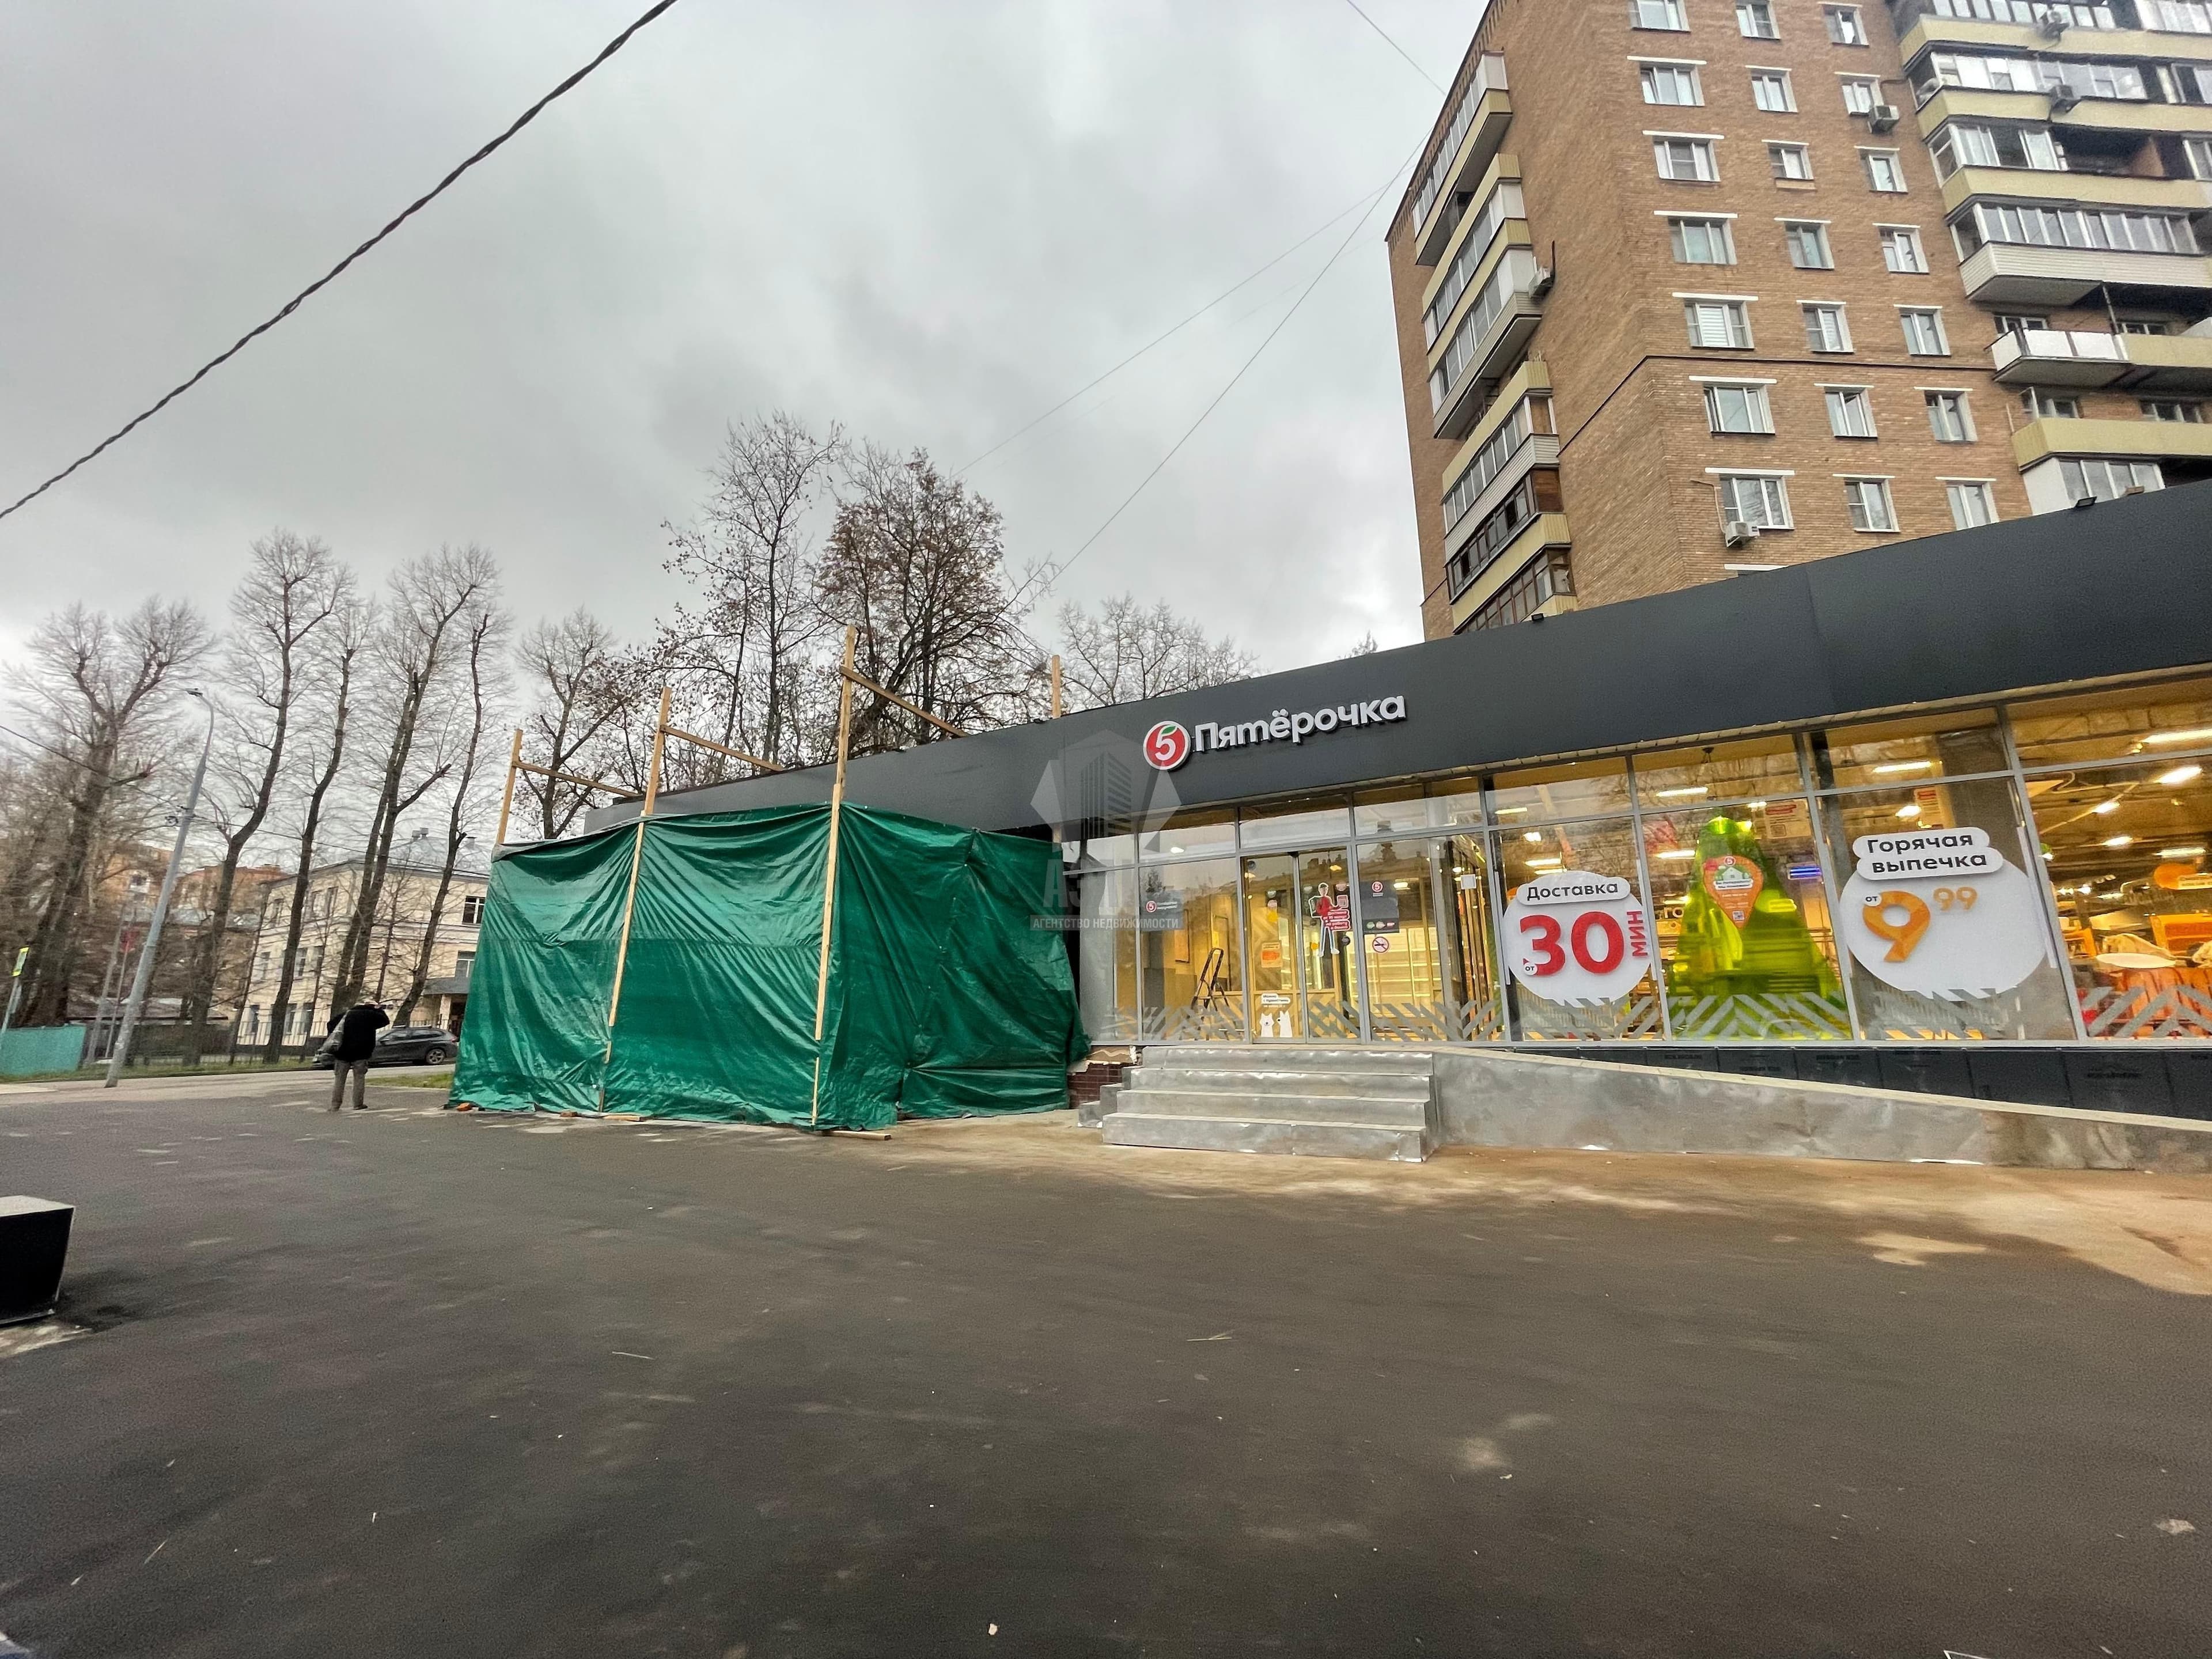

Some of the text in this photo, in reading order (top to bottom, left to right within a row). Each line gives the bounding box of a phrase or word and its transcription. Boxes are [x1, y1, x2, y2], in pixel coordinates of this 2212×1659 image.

[1195, 695, 1406, 752] Пятёрочка
[1867, 835, 1974, 855] Горячая
[1872, 854, 1987, 873] выпечка
[1527, 883, 1618, 902] Доставка
[1519, 910, 1625, 977] 30
